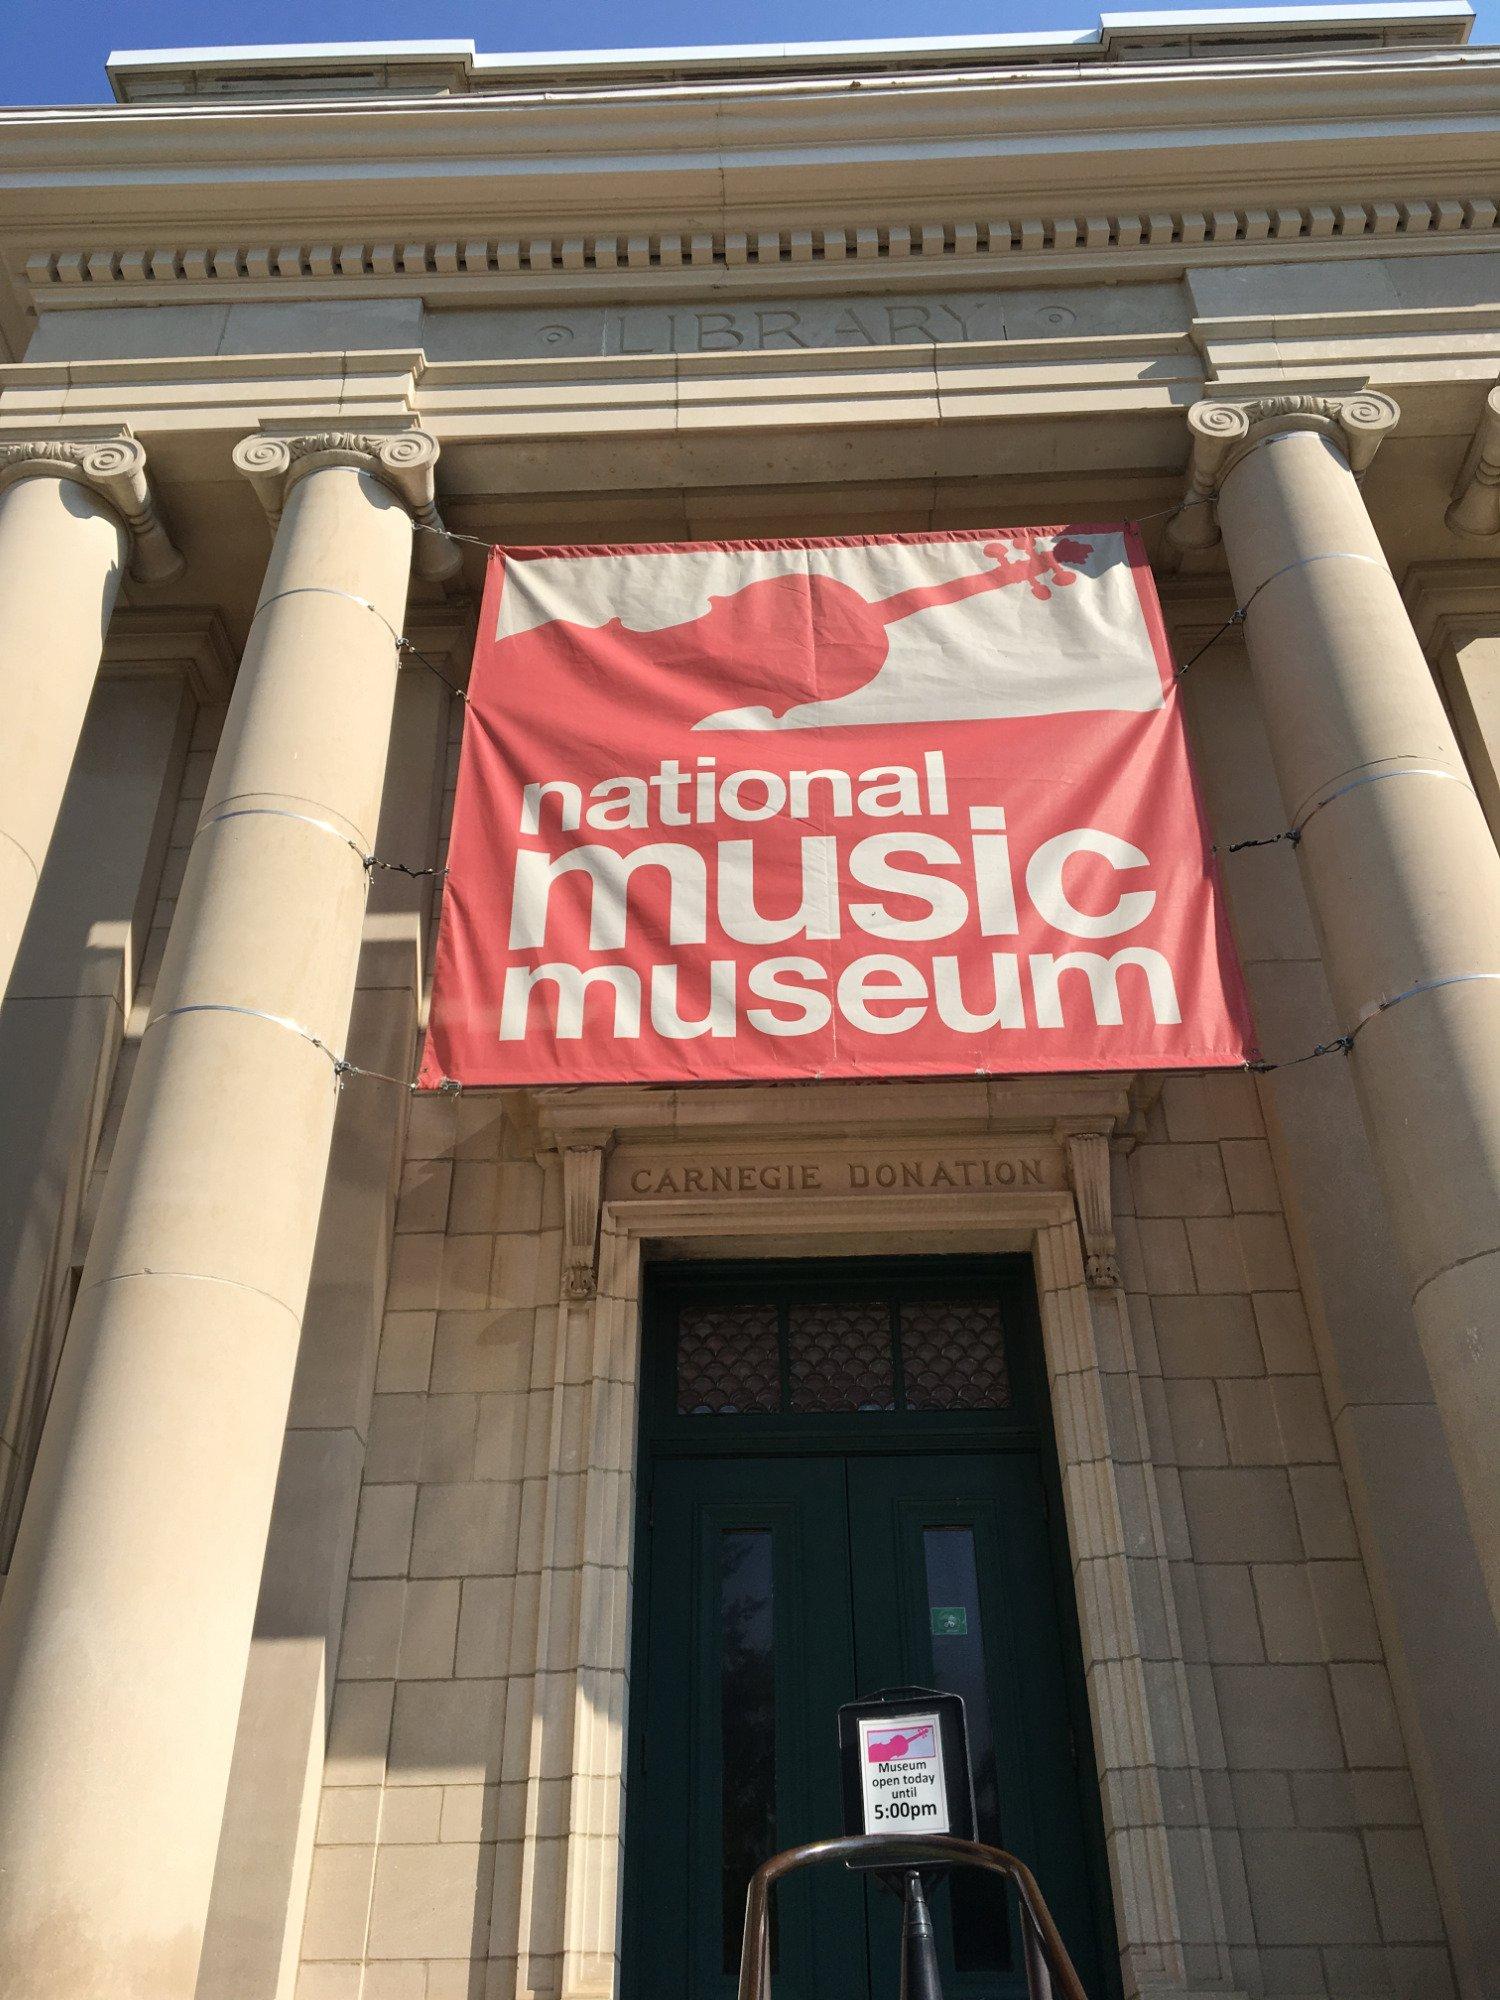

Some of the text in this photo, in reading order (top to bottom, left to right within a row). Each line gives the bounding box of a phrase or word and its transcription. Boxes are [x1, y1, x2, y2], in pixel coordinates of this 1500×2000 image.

[617, 302, 984, 354] LIBRARY
[519, 750, 949, 835] national
[508, 806, 1157, 951] music
[499, 946, 1182, 1041] museum
[630, 1158, 1045, 1194] CARNEGIE DONATION
[872, 1773, 935, 1789] open today
[878, 1761, 927, 1773] Museum
[874, 1802, 937, 1820] 5:00pm
[892, 1787, 917, 1799] until
